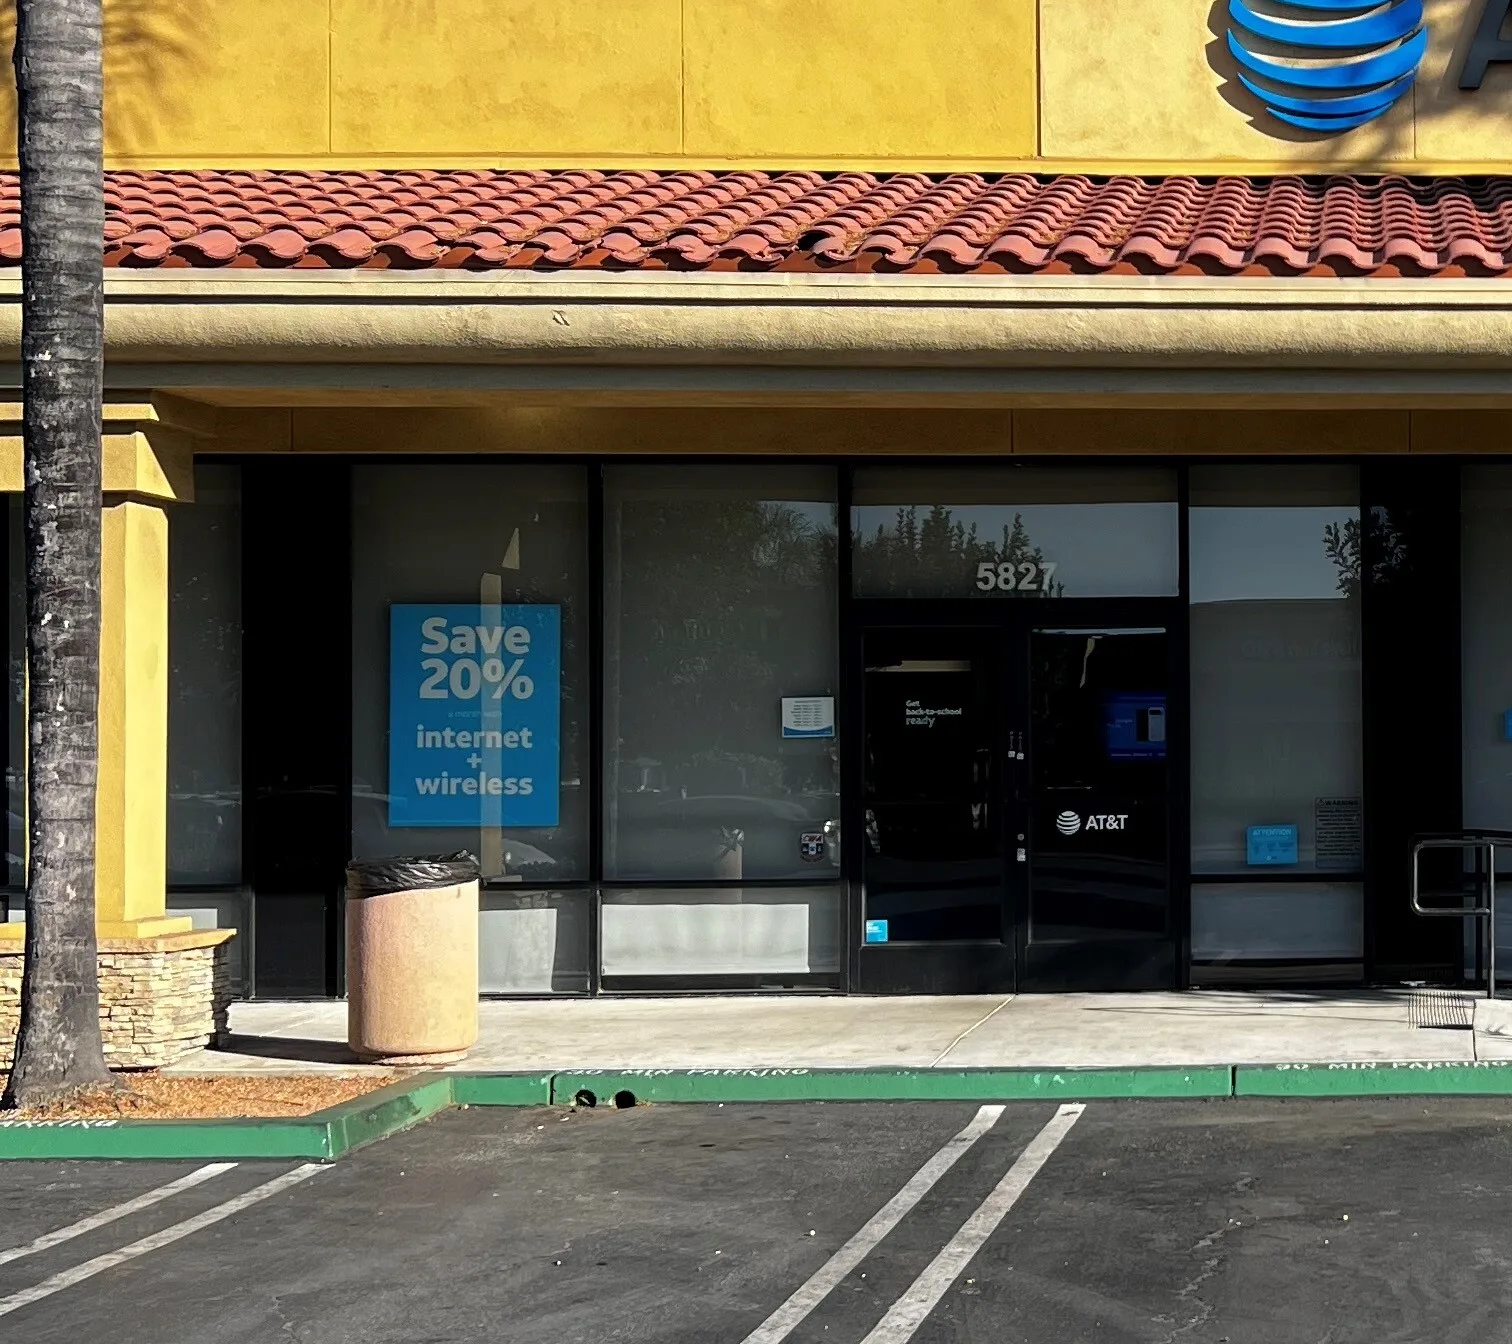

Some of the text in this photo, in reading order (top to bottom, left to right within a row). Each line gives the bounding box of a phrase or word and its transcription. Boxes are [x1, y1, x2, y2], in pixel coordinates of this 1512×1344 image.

[976, 561, 1058, 591] 5827
[421, 616, 531, 654] Save
[419, 658, 535, 700] 20%
[905, 699, 920, 707] Get
[905, 716, 936, 728] ready
[416, 724, 533, 749] internet
[466, 752, 483, 769] +
[415, 771, 534, 796] wireless
[1085, 814, 1129, 831] AT&T
[1252, 828, 1292, 837] ATTENTION
[620, 1068, 674, 1077] MIN
[1328, 1061, 1377, 1070] MIN
